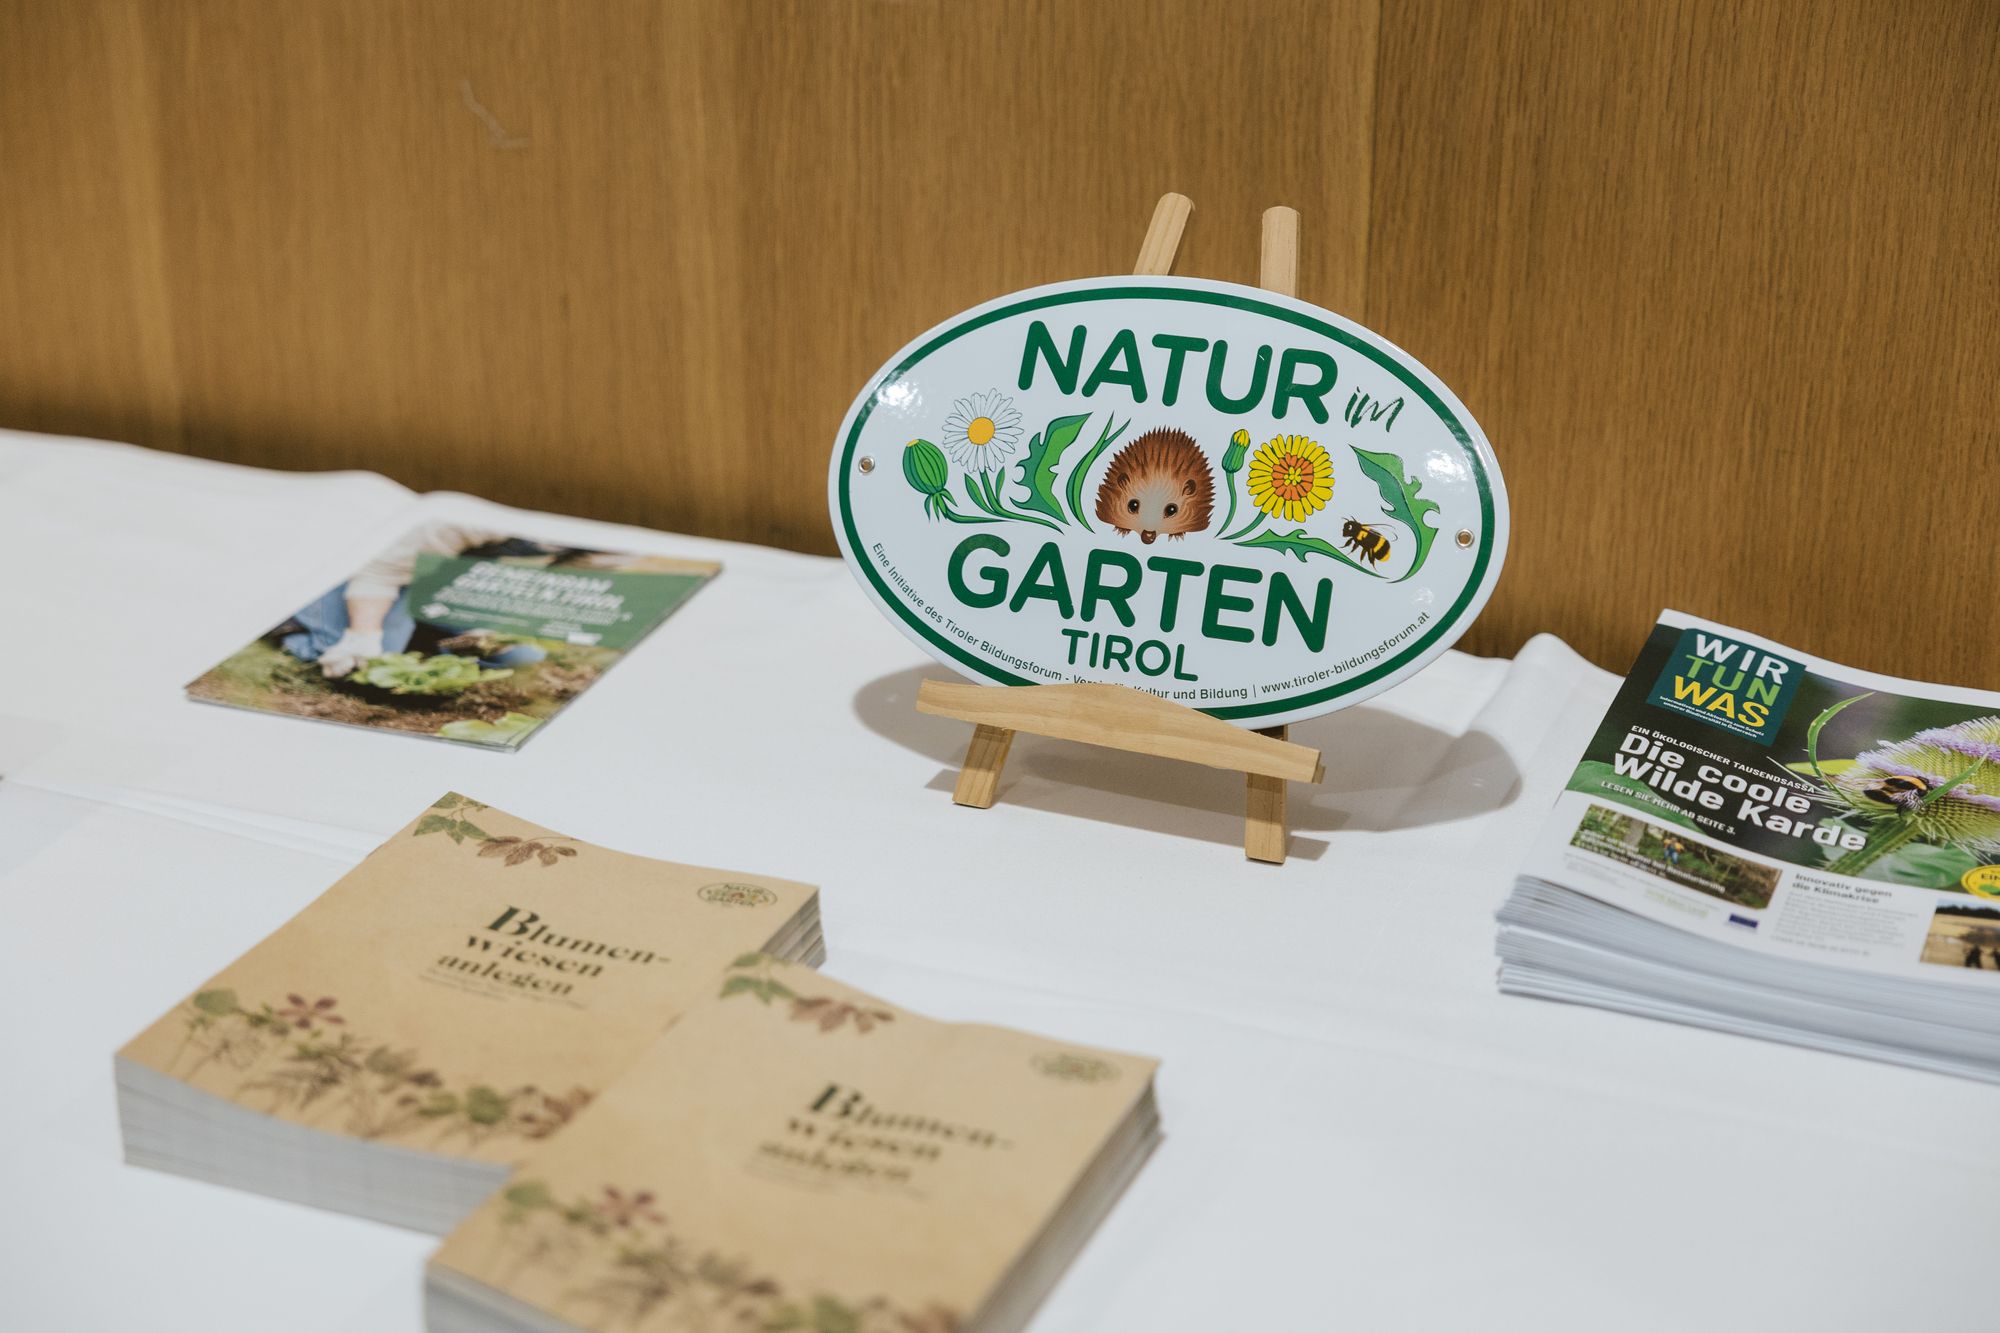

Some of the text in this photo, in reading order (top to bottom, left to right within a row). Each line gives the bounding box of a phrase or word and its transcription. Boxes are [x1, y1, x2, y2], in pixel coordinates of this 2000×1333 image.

[1018, 320, 1405, 432] NATUR im
[947, 533, 1334, 653] GARTEN
[872, 543, 890, 568] Eine
[888, 566, 925, 608] Initiative
[924, 604, 944, 624] des
[945, 618, 980, 647] Tiroler
[979, 640, 1062, 682] Bildungsforum
[1173, 688, 1196, 700] und
[1200, 686, 1248, 699] Bildung
[1261, 611, 1431, 694] www.tiroler-bildungsforum.at
[1061, 628, 1199, 682] TIROL
[1685, 654, 1781, 706] TUN
[1696, 633, 1789, 685] WIR
[1674, 675, 1770, 727] WAS
[1696, 707, 1707, 715] und
[1745, 726, 1765, 736] Schutz
[1727, 722, 1758, 738] Österreich
[1619, 732, 1811, 814] Die coole
[1631, 725, 1816, 794] EIN ÖKOLOGISCHER TAUSENDSASSA
[1601, 780, 1634, 796] LESEN
[1635, 791, 1651, 802] SIE
[1650, 796, 1682, 815] MEHR
[1680, 809, 1697, 820] AB
[1696, 814, 1726, 831] SEITE
[1614, 753, 1867, 851] Wilde Karde
[1792, 881, 1880, 904] die Klimakrise
[1795, 873, 1893, 898] Innovativ gegen
[466, 935, 604, 978] wiesen
[485, 906, 672, 964] Blumen-
[437, 955, 574, 996] anlegen
